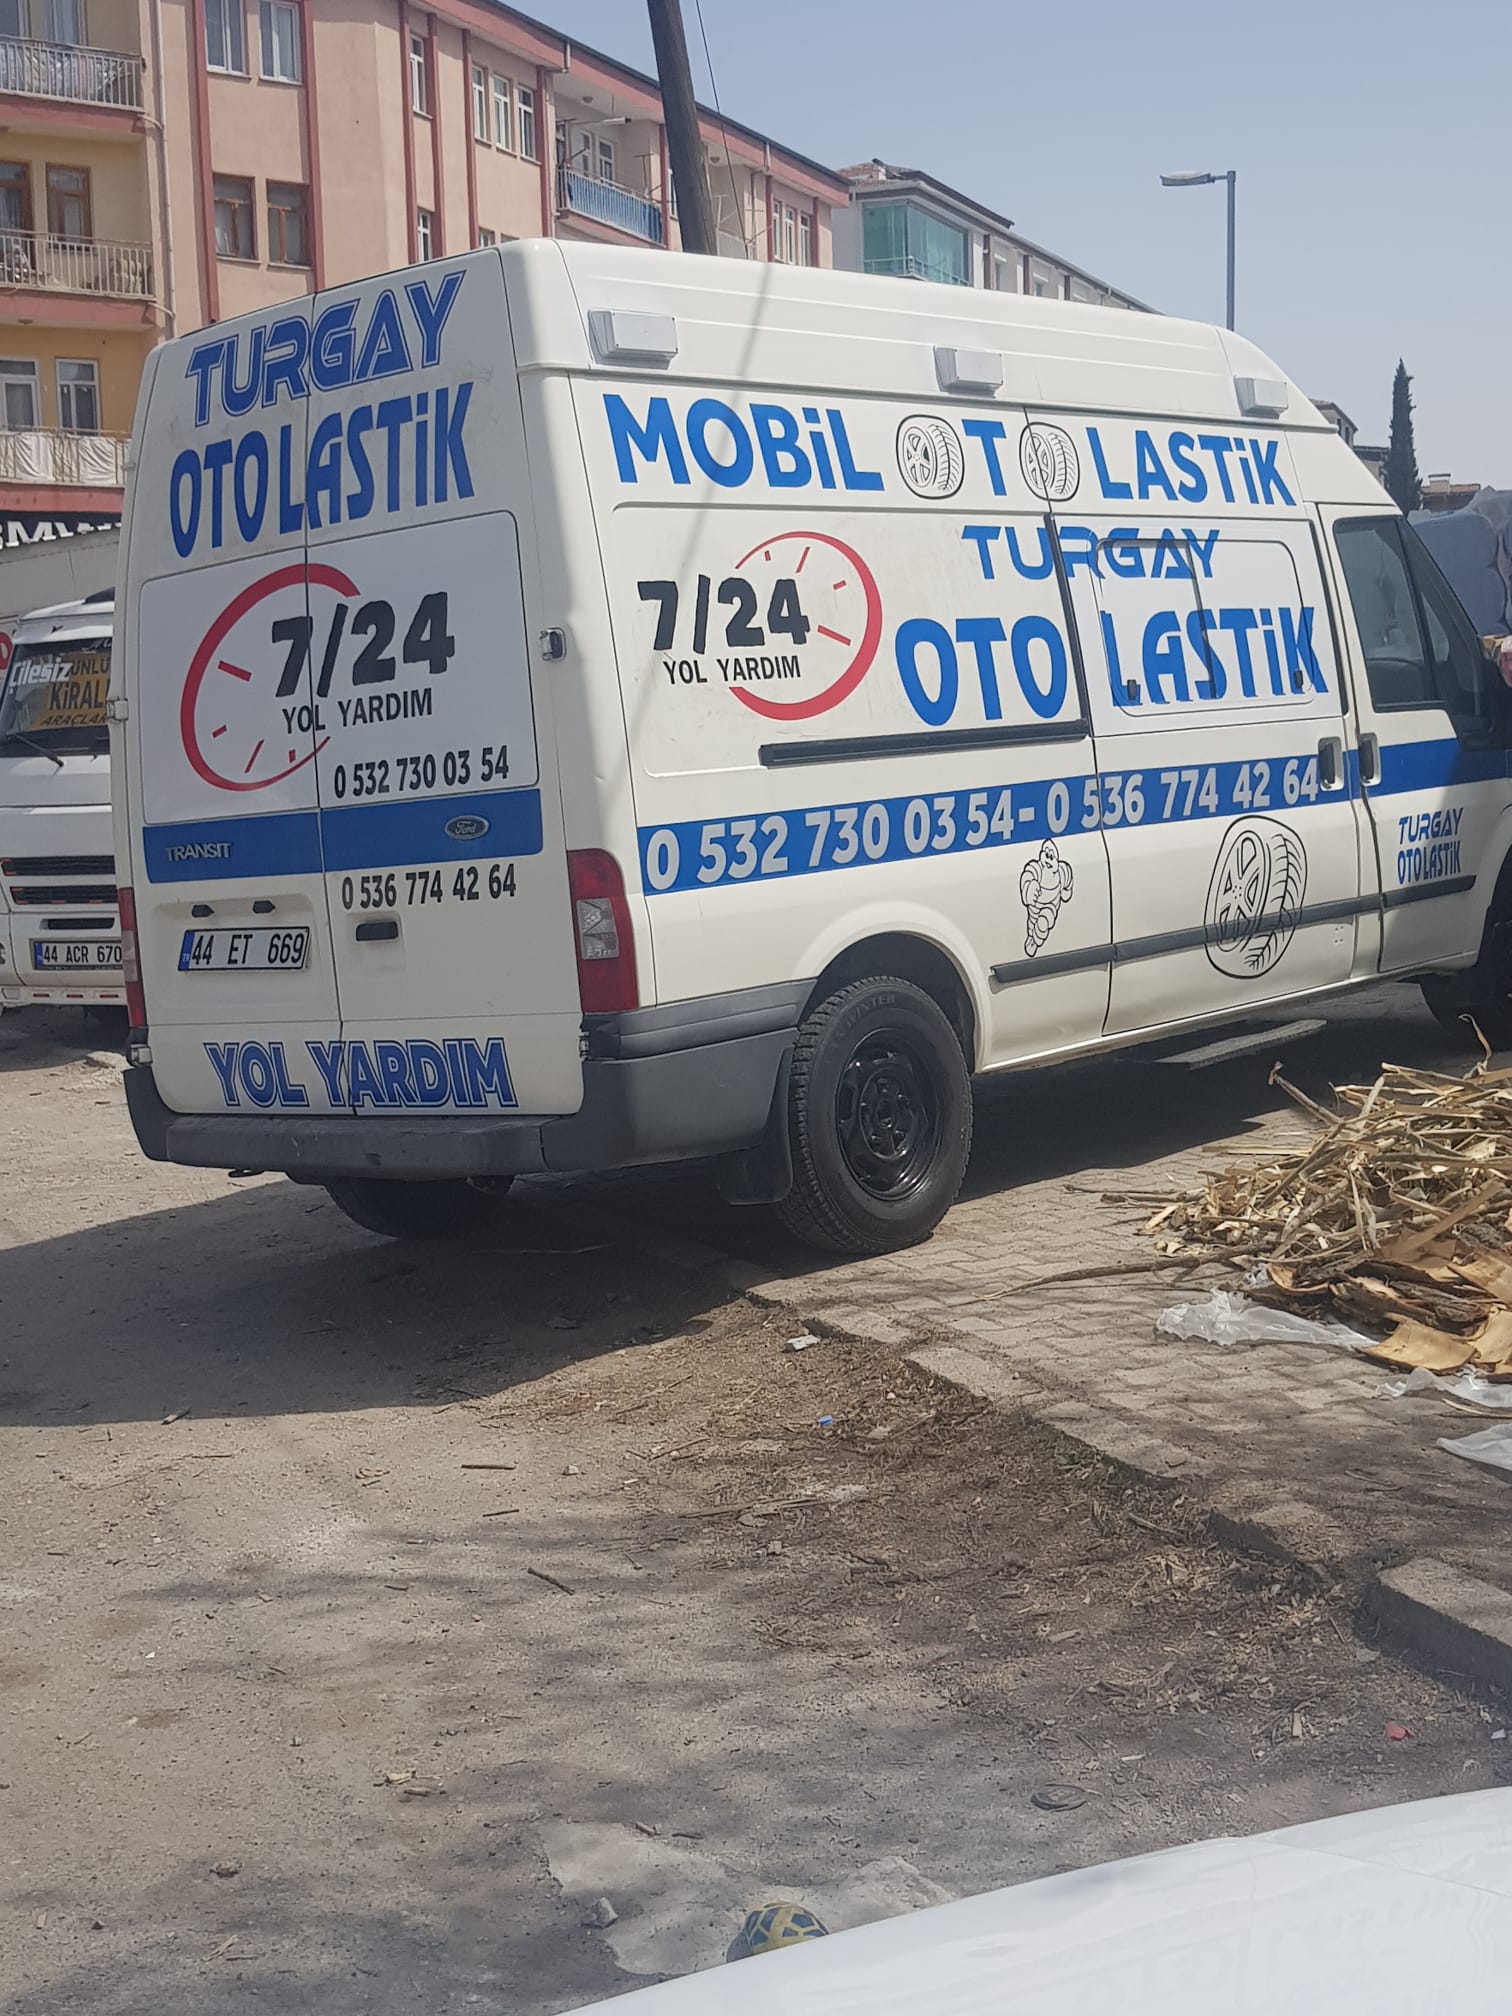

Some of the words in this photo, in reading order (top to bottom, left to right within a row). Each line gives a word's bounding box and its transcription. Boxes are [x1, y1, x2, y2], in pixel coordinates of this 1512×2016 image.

[185, 270, 466, 427] TURGAY
[170, 431, 268, 558] OTO
[961, 525, 1220, 580] TURGAY
[637, 573, 811, 655] 7/24
[272, 591, 455, 698] 7/24
[663, 659, 708, 684] YOL
[716, 655, 801, 682] YARDIM
[895, 616, 1067, 726] OTO
[282, 704, 326, 735] YOL
[338, 688, 433, 727] YARDIM
[334, 765, 346, 798] 0
[353, 760, 390, 797] 532
[397, 754, 436, 791] 730
[443, 750, 471, 786] 03
[480, 745, 509, 782] 54
[646, 829, 680, 890] 0
[696, 815, 789, 884] 532
[804, 803, 889, 867] 730
[904, 796, 956, 854] 03
[1047, 781, 1069, 833] 0
[1081, 773, 1145, 829] 536
[1160, 767, 1218, 819] 774
[1232, 761, 1271, 809] 42
[1283, 758, 1318, 805] 64
[1399, 807, 1463, 845] TURGAY
[166, 842, 232, 861] TRANSIT
[1397, 847, 1421, 885] OTO
[342, 877, 354, 909] 0
[360, 873, 397, 909] 536
[405, 870, 443, 905] 774
[453, 866, 479, 901] 42
[489, 863, 516, 899] 64
[44, 945, 58, 962] 44
[65, 945, 88, 963] ACR
[97, 945, 122, 963] 670
[192, 935, 214, 965] 44
[227, 934, 253, 964] ET
[267, 933, 305, 963] 669
[204, 1040, 309, 1108] YOL
[306, 1037, 519, 1109] YARDIM
